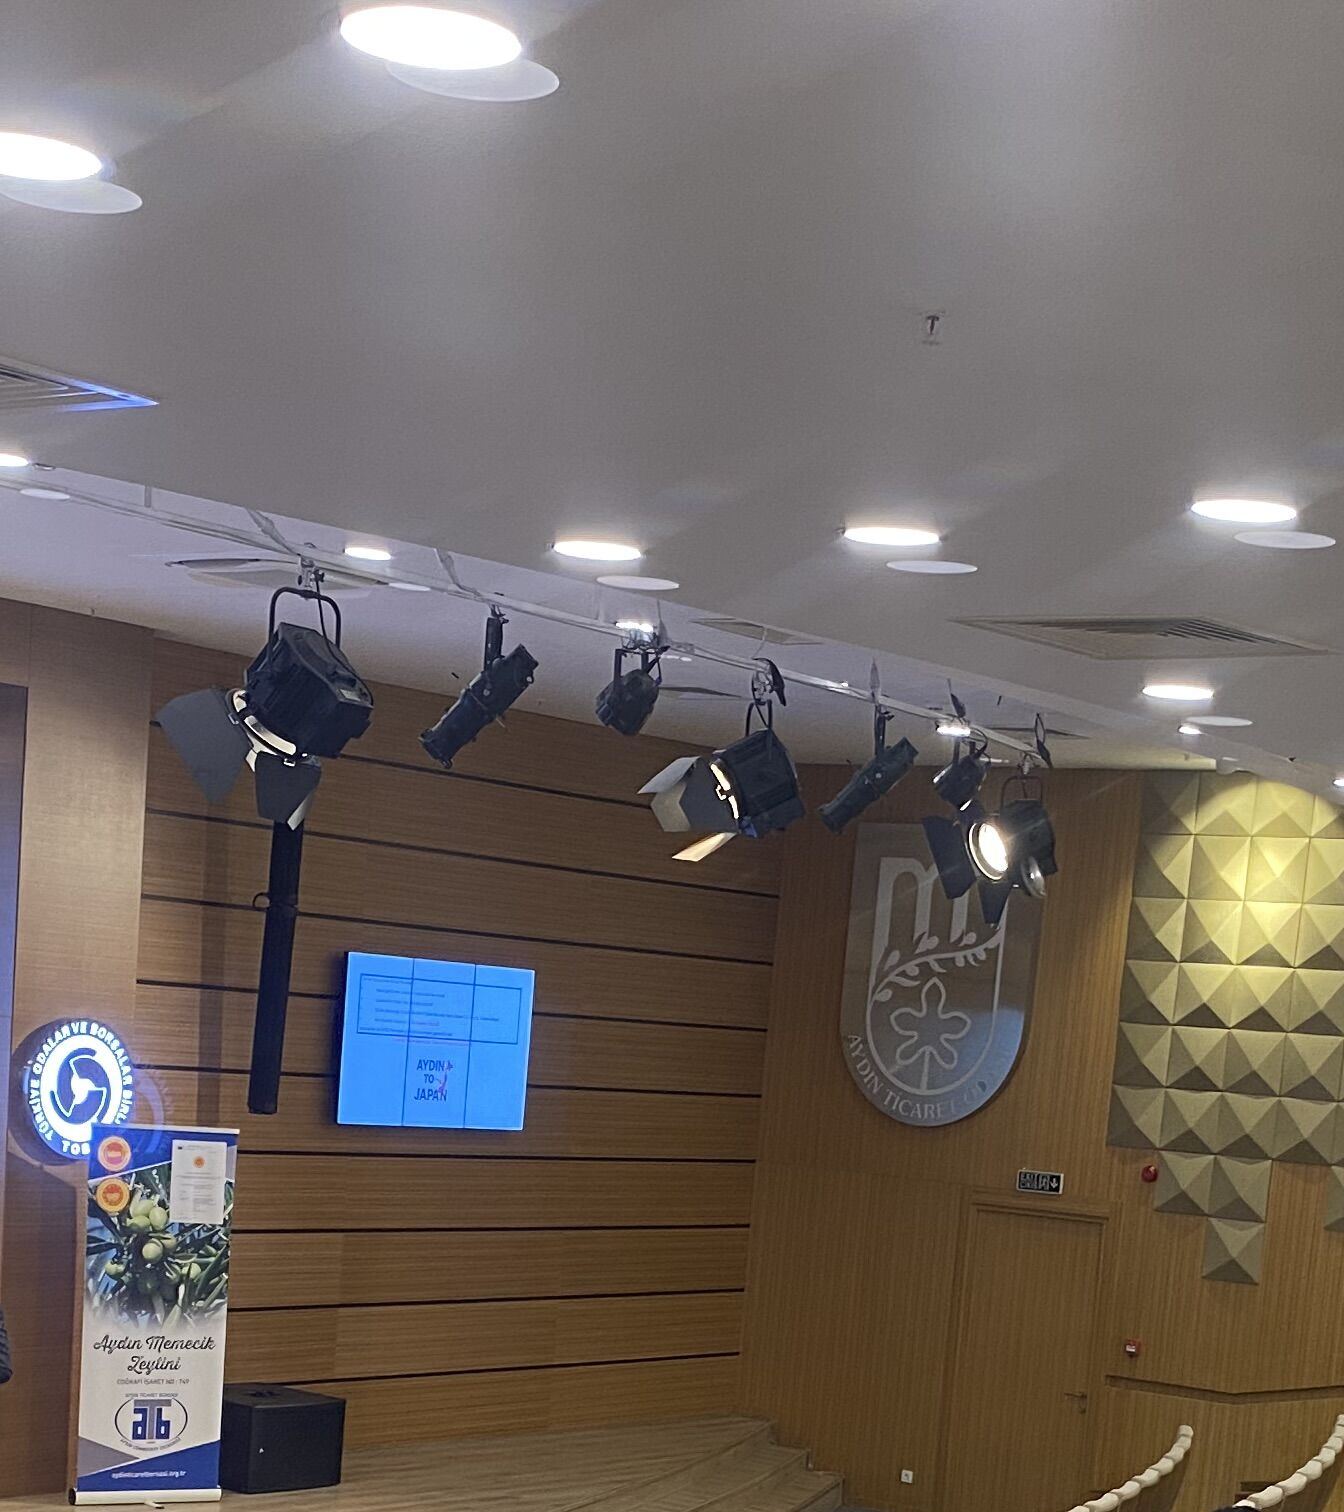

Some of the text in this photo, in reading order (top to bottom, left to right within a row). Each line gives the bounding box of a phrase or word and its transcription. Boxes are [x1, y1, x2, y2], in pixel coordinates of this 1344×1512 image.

[71, 1021, 88, 1034] VE
[416, 1058, 445, 1072] AYDIN
[848, 1034, 884, 1094] AYDIN
[424, 1073, 435, 1084] TO
[414, 1088, 447, 1102] JAPAN
[62, 1140, 91, 1155] TOB
[93, 1334, 216, 1354] Aydın Memecik
